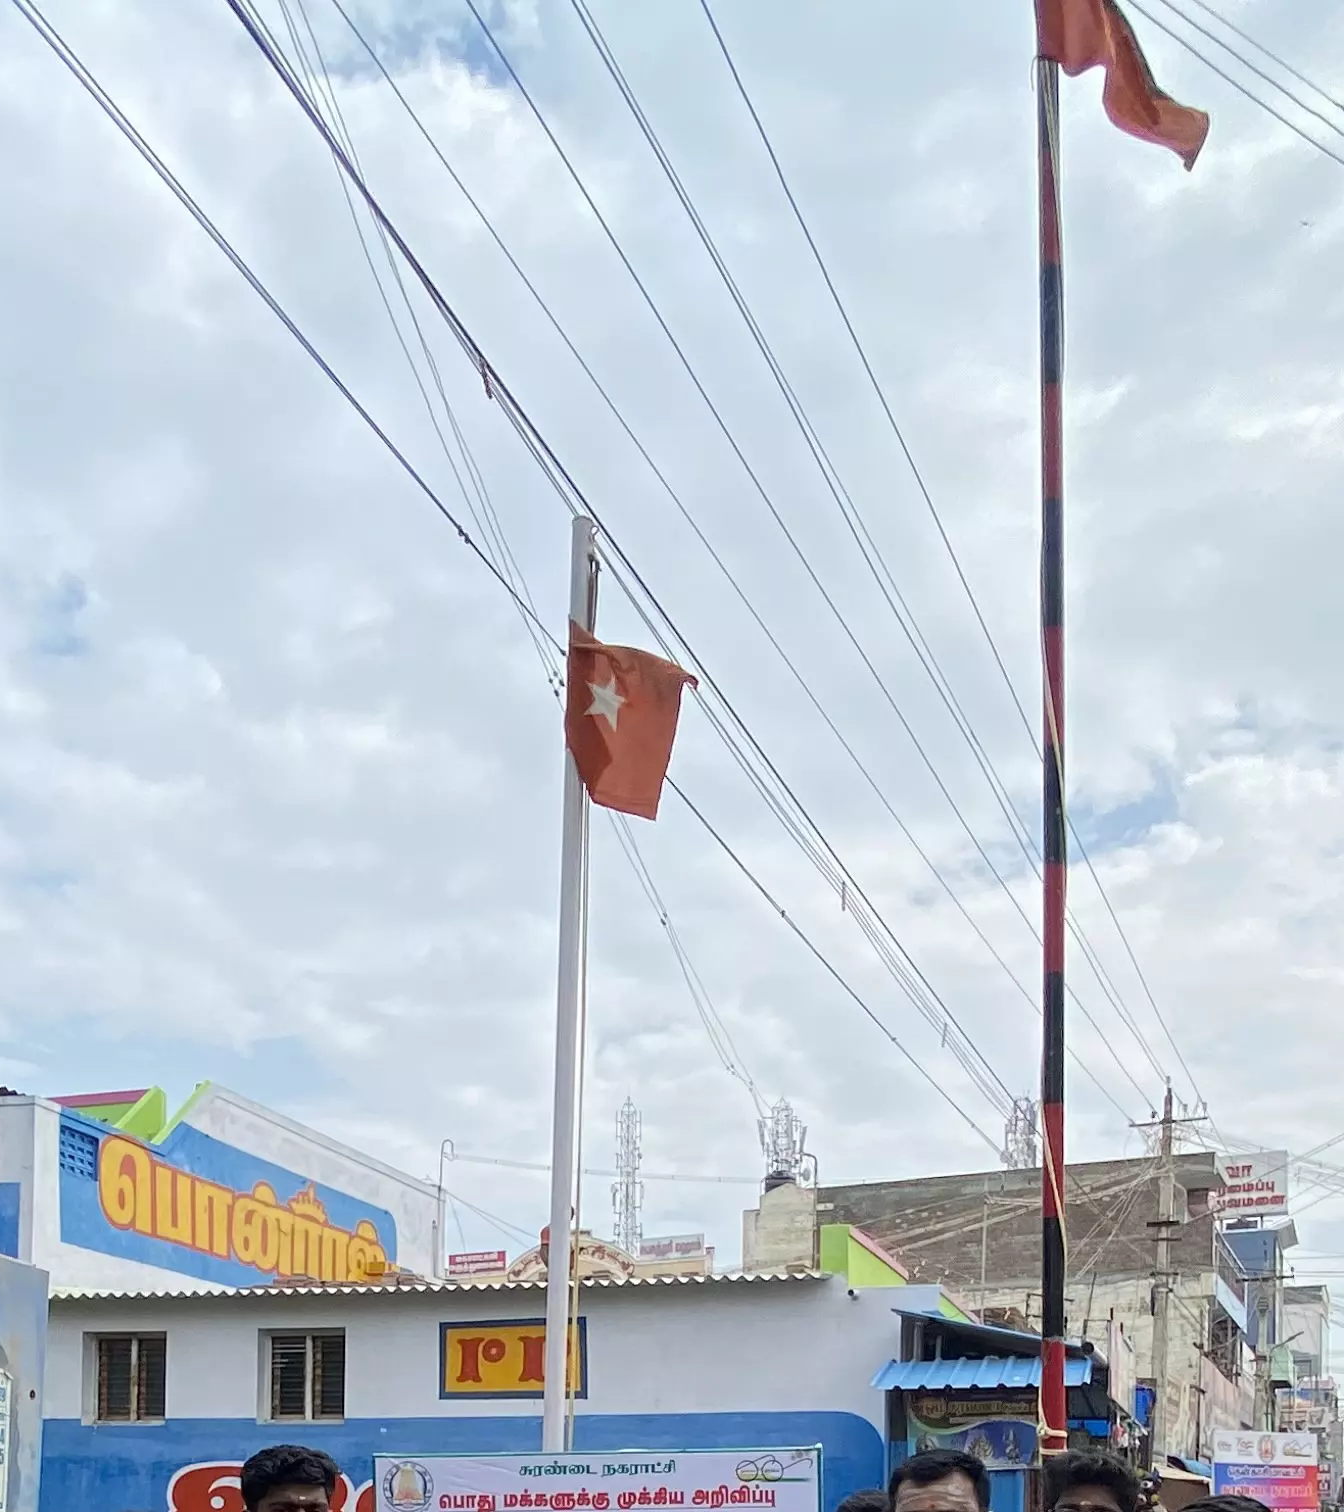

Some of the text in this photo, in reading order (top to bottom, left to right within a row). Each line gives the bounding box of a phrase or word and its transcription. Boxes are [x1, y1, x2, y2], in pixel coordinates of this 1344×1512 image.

[98, 1133, 389, 1284] பொன்ராஜ்
[519, 1459, 676, 1477] சுரண்டை நகராட்சி
[504, 1488, 610, 1511] மக்களுக்கு
[616, 1486, 684, 1510] முக்கிய
[691, 1484, 776, 1508] அறிவிப்பு
